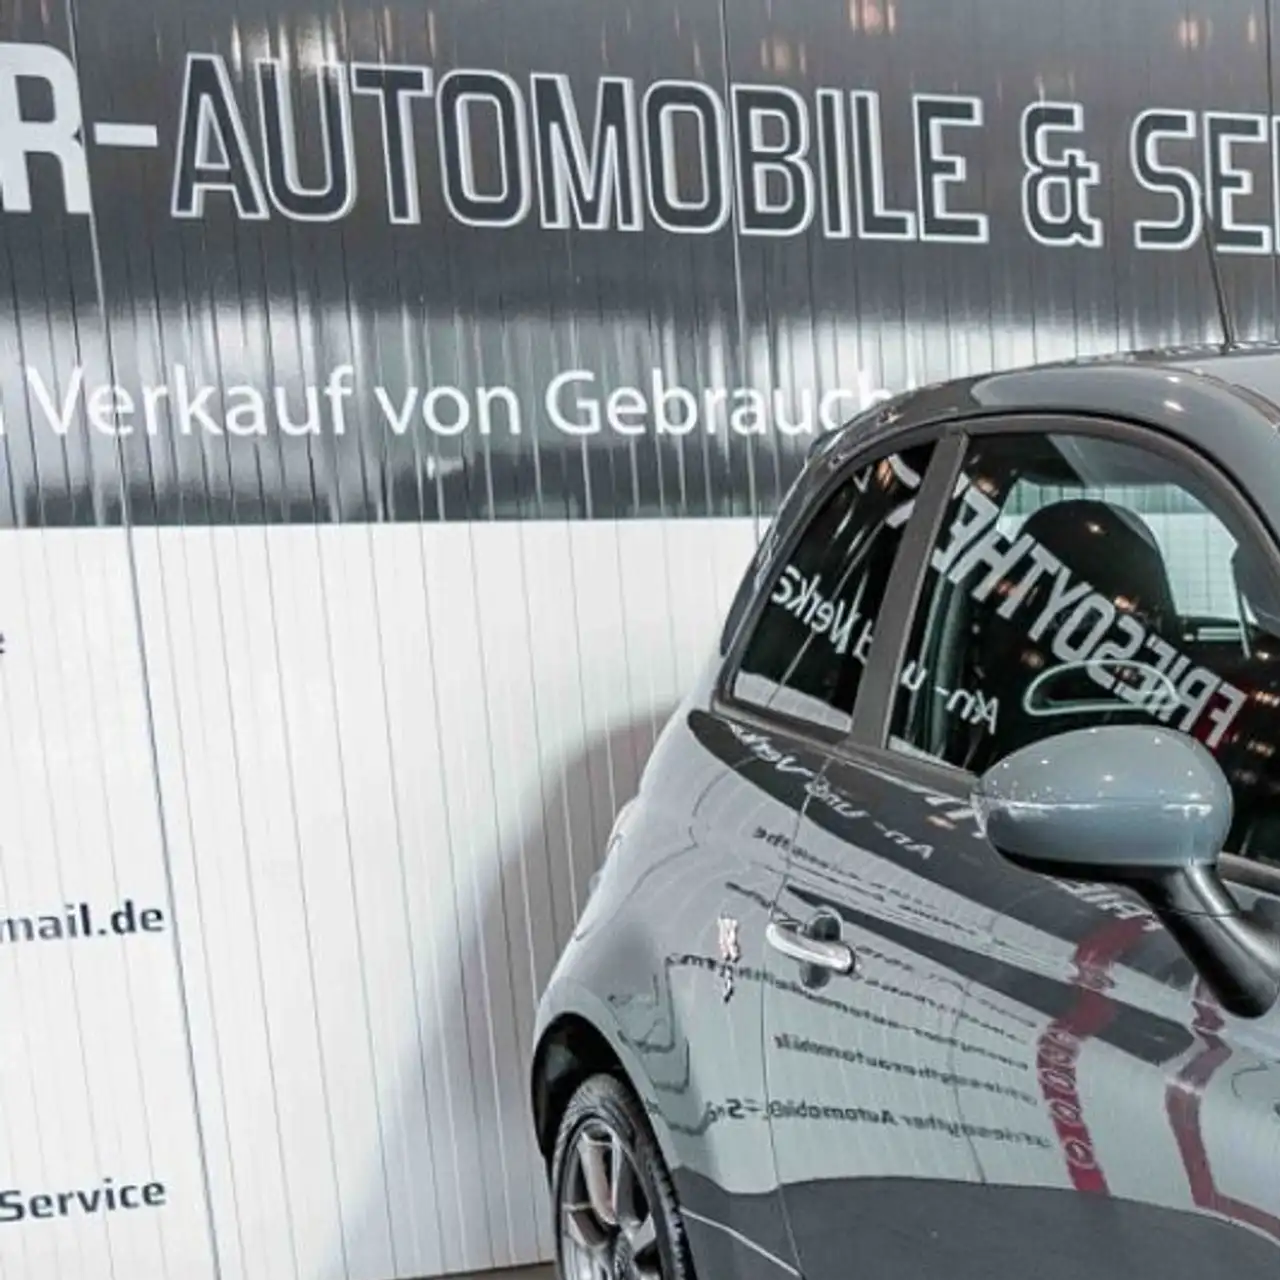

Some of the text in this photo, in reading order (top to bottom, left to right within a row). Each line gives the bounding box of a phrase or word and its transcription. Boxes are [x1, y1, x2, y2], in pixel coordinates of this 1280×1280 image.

[1021, 101, 1104, 248] &
[26, 363, 353, 437] Verkauf
[375, 386, 520, 436] von
[0, 1177, 166, 1223] Service
